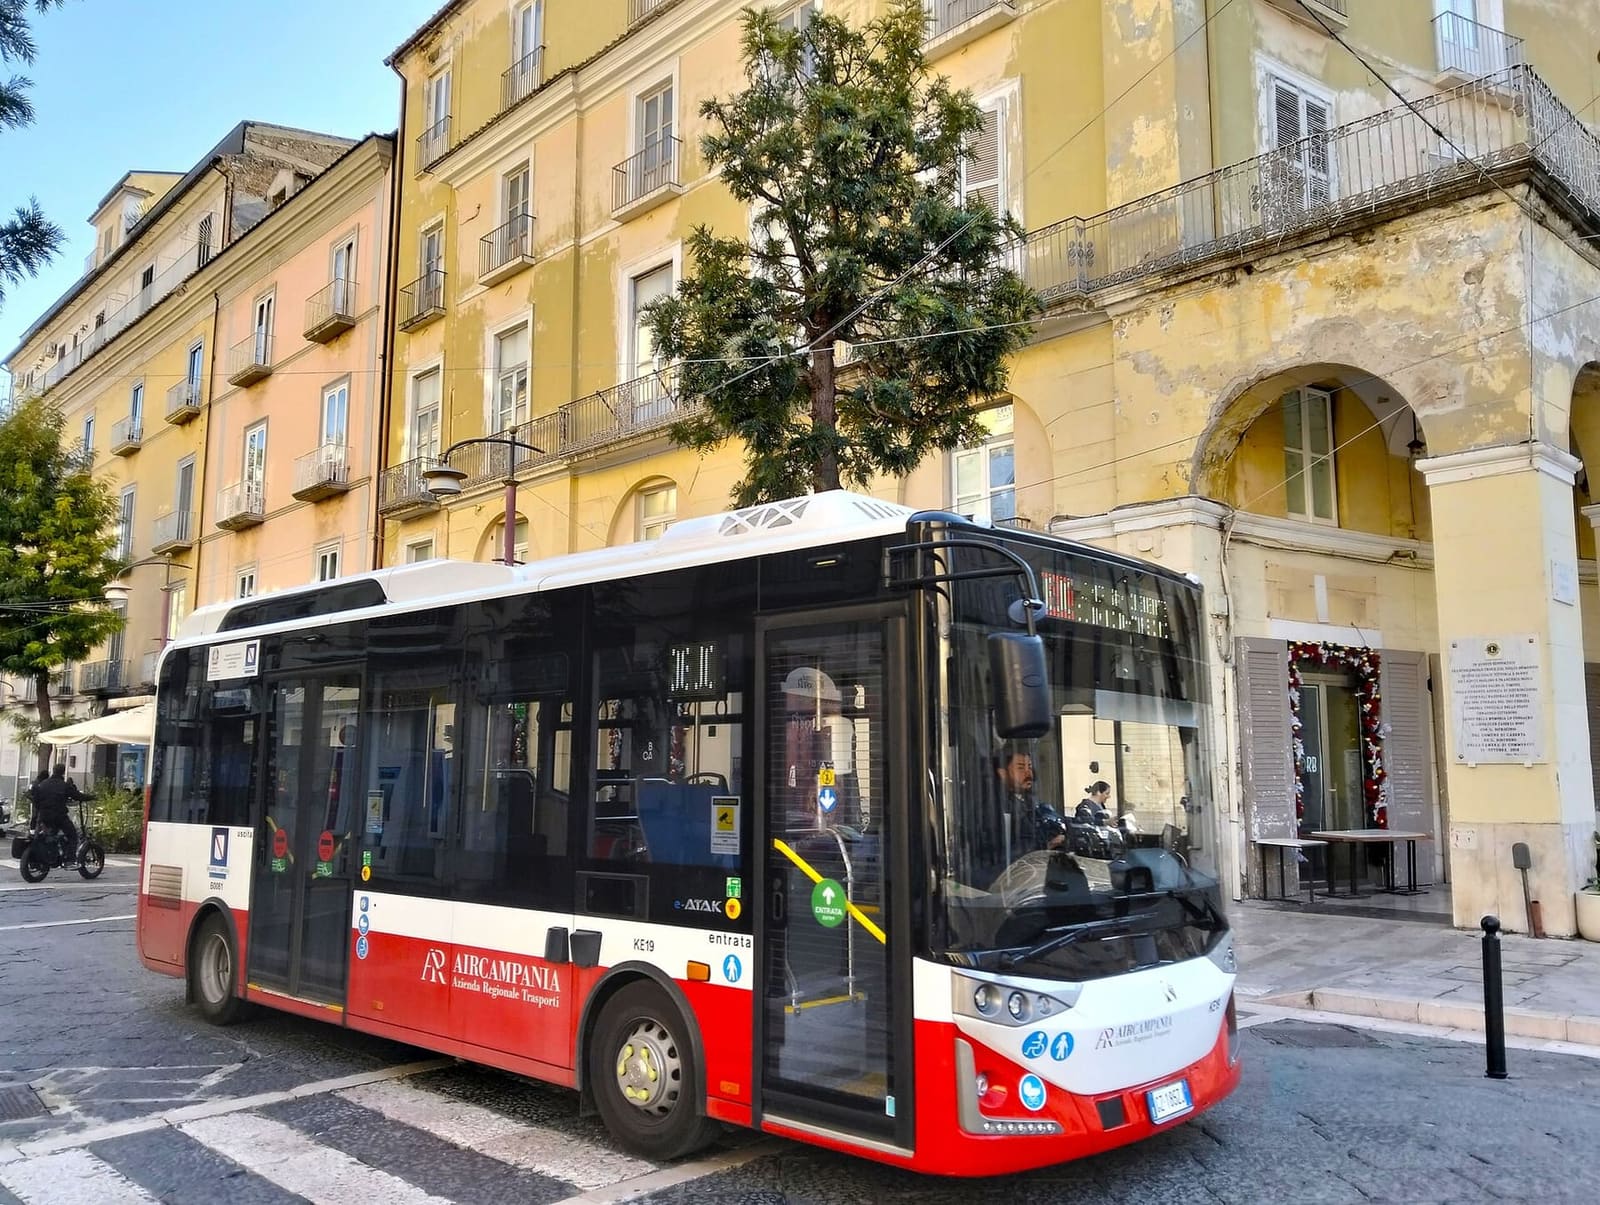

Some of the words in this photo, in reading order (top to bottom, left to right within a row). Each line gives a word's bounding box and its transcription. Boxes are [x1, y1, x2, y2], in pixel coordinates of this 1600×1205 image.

[674, 899, 722, 913] e-ATAK
[633, 938, 655, 952] KE19
[709, 934, 751, 948] entrata
[453, 952, 561, 993] AIRCAMPANIA
[452, 976, 481, 992] Azienda
[482, 981, 520, 999] Regionale
[522, 989, 560, 1008] Trasporti
[1117, 1015, 1173, 1039] AIRCAMPANIA
